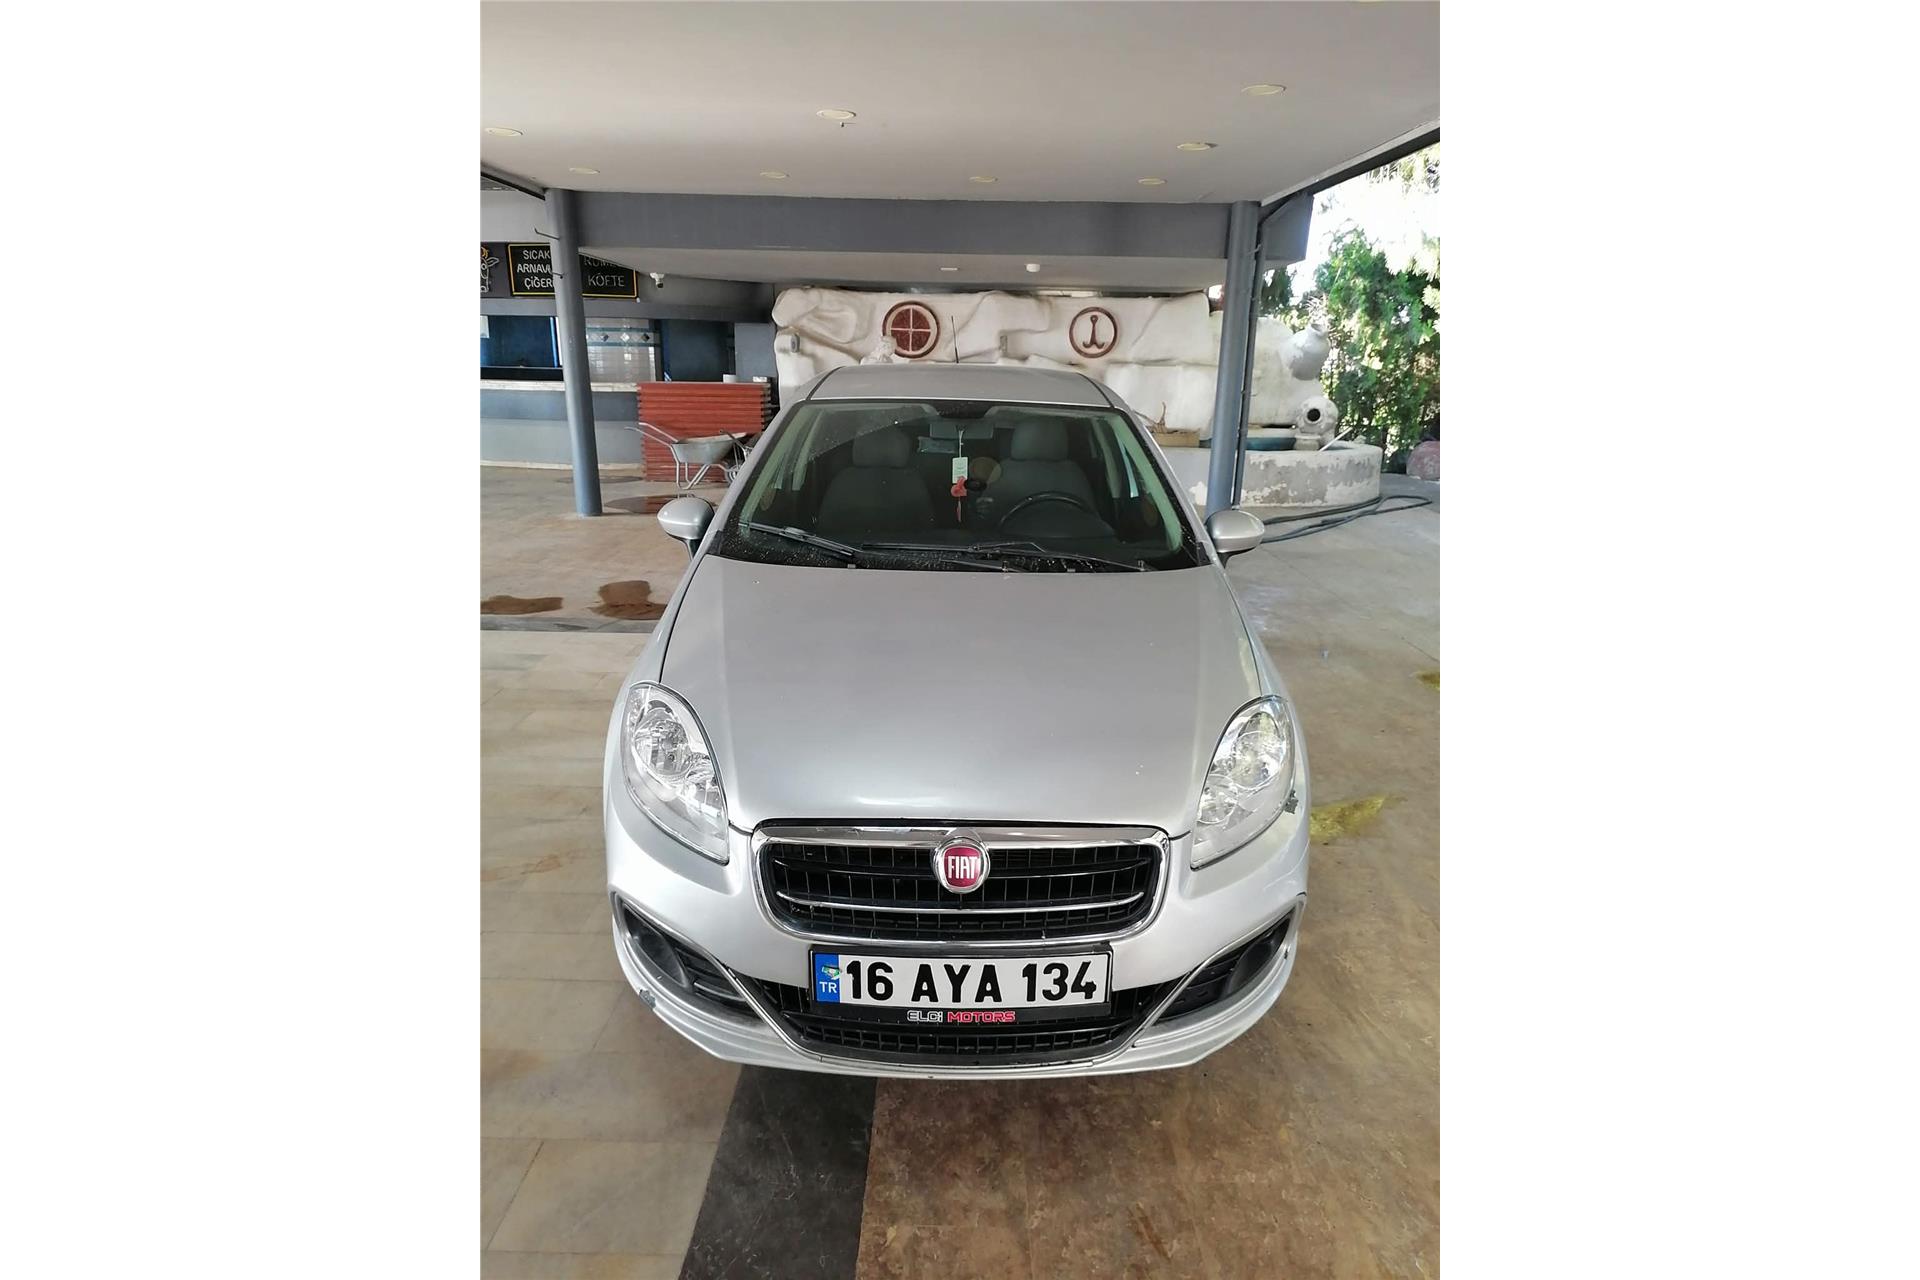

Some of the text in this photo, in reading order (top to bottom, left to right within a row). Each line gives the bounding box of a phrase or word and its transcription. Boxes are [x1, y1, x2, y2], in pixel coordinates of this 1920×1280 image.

[523, 250, 551, 260] SICAK
[588, 273, 625, 287] KÖFTE
[947, 855, 978, 879] FIAT
[819, 981, 838, 994] TR
[846, 960, 1097, 1003] 16 AYA 134
[947, 1011, 1016, 1023] MOTORS
